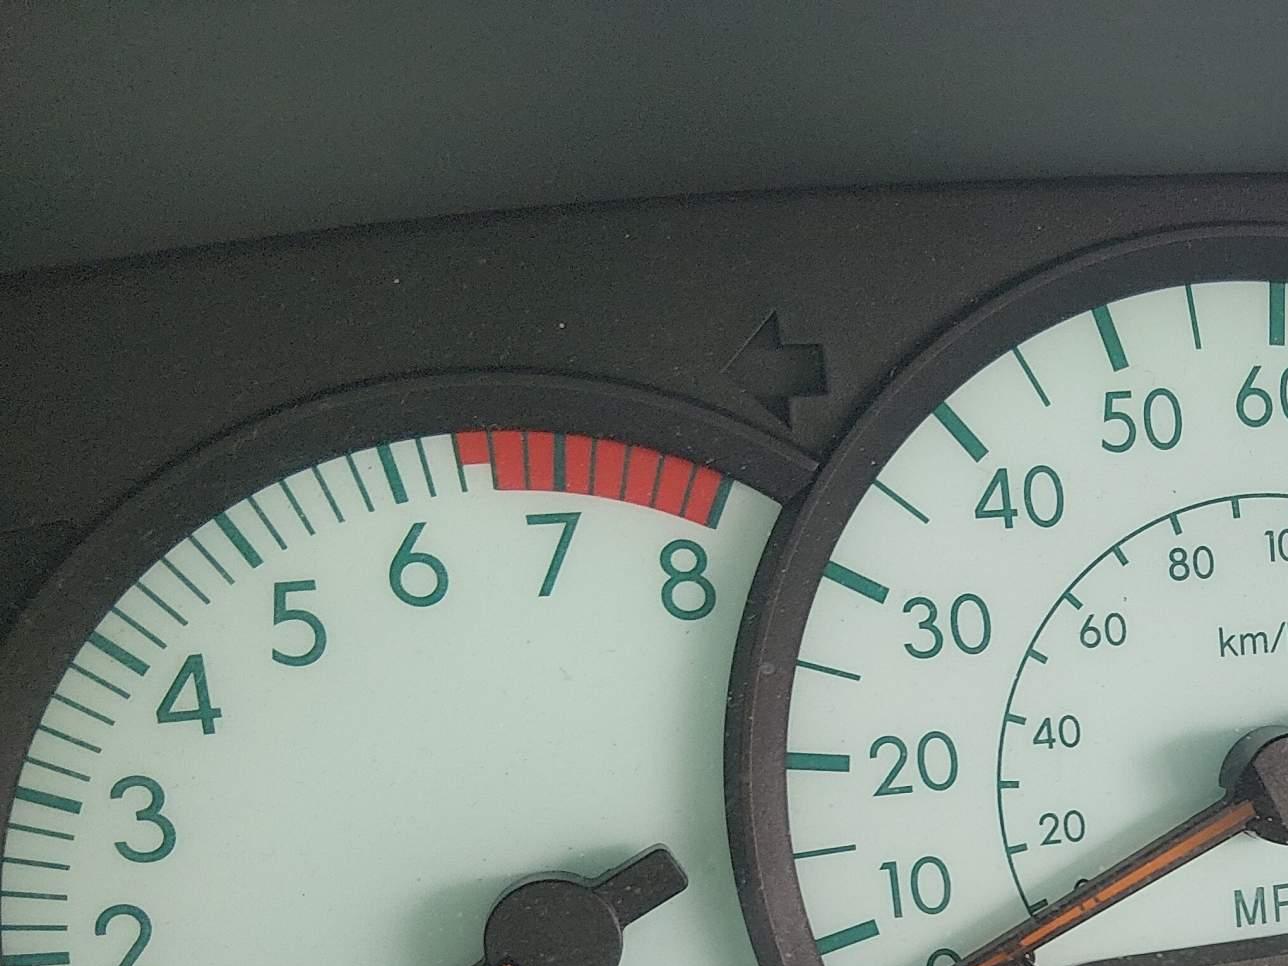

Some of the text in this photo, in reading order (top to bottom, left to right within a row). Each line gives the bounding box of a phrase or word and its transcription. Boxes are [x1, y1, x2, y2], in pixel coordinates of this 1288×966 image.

[1102, 388, 1182, 453] 50
[974, 465, 1064, 529] 40
[389, 522, 448, 607] 6
[526, 512, 582, 597] 7
[660, 539, 716, 620] 8
[1169, 546, 1214, 581] 80
[272, 580, 326, 666] 5
[903, 593, 991, 659] 30
[1080, 613, 1126, 648] 60
[156, 654, 222, 734] 4
[870, 731, 958, 796] 20
[1033, 715, 1080, 749] 40
[110, 775, 176, 863] 3
[1039, 810, 1085, 845] 20
[880, 856, 951, 918] 10
